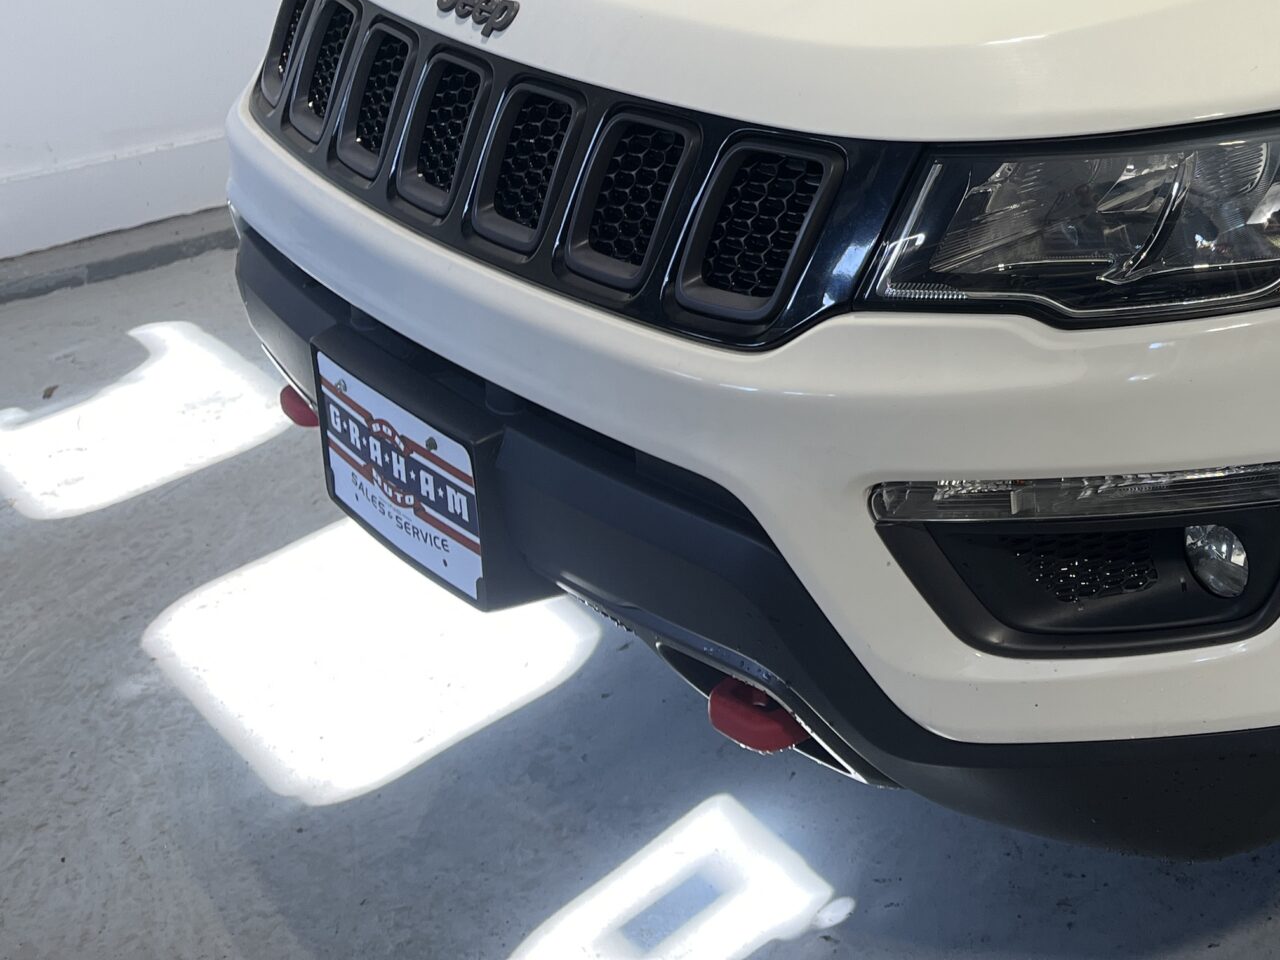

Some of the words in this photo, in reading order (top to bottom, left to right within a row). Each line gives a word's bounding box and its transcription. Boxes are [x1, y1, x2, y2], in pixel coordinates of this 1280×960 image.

[351, 471, 386, 515] SALES
[396, 515, 450, 553] SERVICE
[372, 468, 415, 506] AUTO
